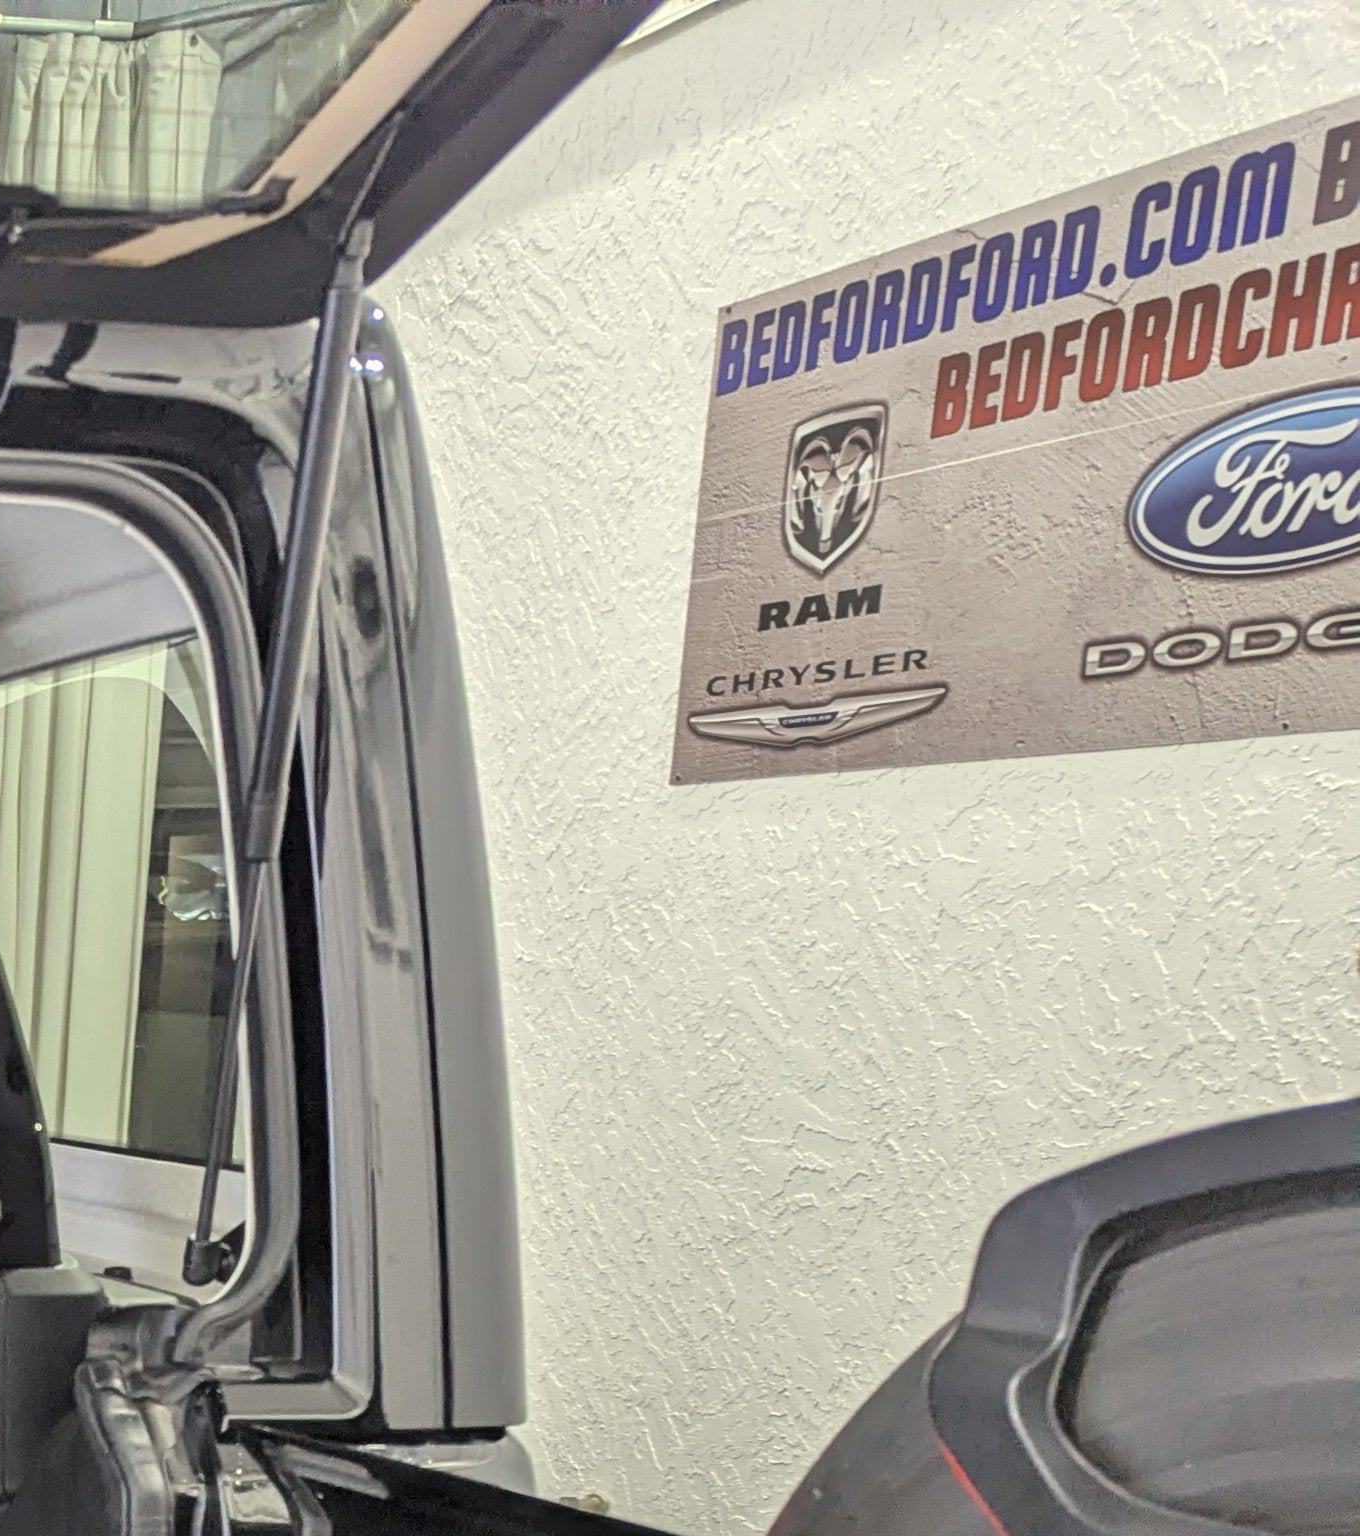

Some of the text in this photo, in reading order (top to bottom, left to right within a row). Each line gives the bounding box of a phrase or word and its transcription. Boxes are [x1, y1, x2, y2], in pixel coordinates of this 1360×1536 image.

[714, 141, 1297, 397] BEDFORDFORD.COM
[756, 583, 883, 632] RAM
[705, 648, 930, 698] CHRYSLER
